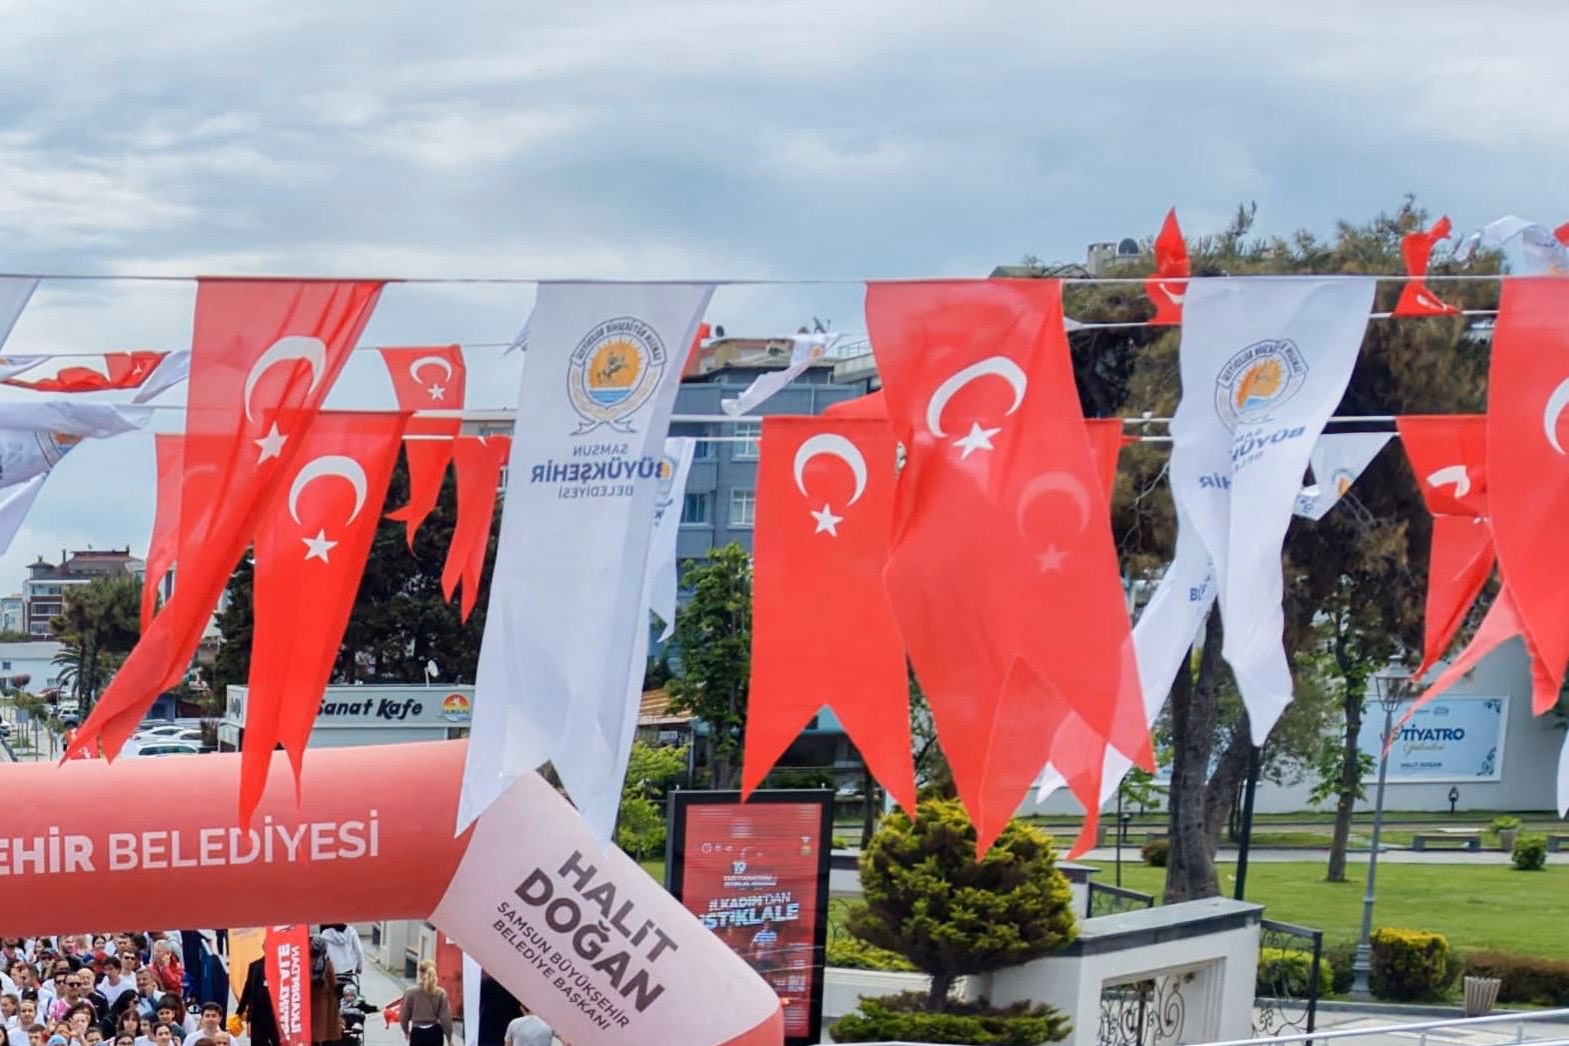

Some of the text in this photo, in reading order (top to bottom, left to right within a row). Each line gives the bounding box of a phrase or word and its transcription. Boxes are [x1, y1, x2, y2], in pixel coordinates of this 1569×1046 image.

[376, 698, 424, 721] Kafe
[108, 809, 379, 871] BELEDİYESİ
[514, 867, 666, 1013] DOĞAN
[557, 850, 679, 963] HALİT
[492, 919, 611, 1031] BELEDİYE BAŞKANI
[496, 901, 631, 1028] SAMSUN BÜYÜKŞEHİR
